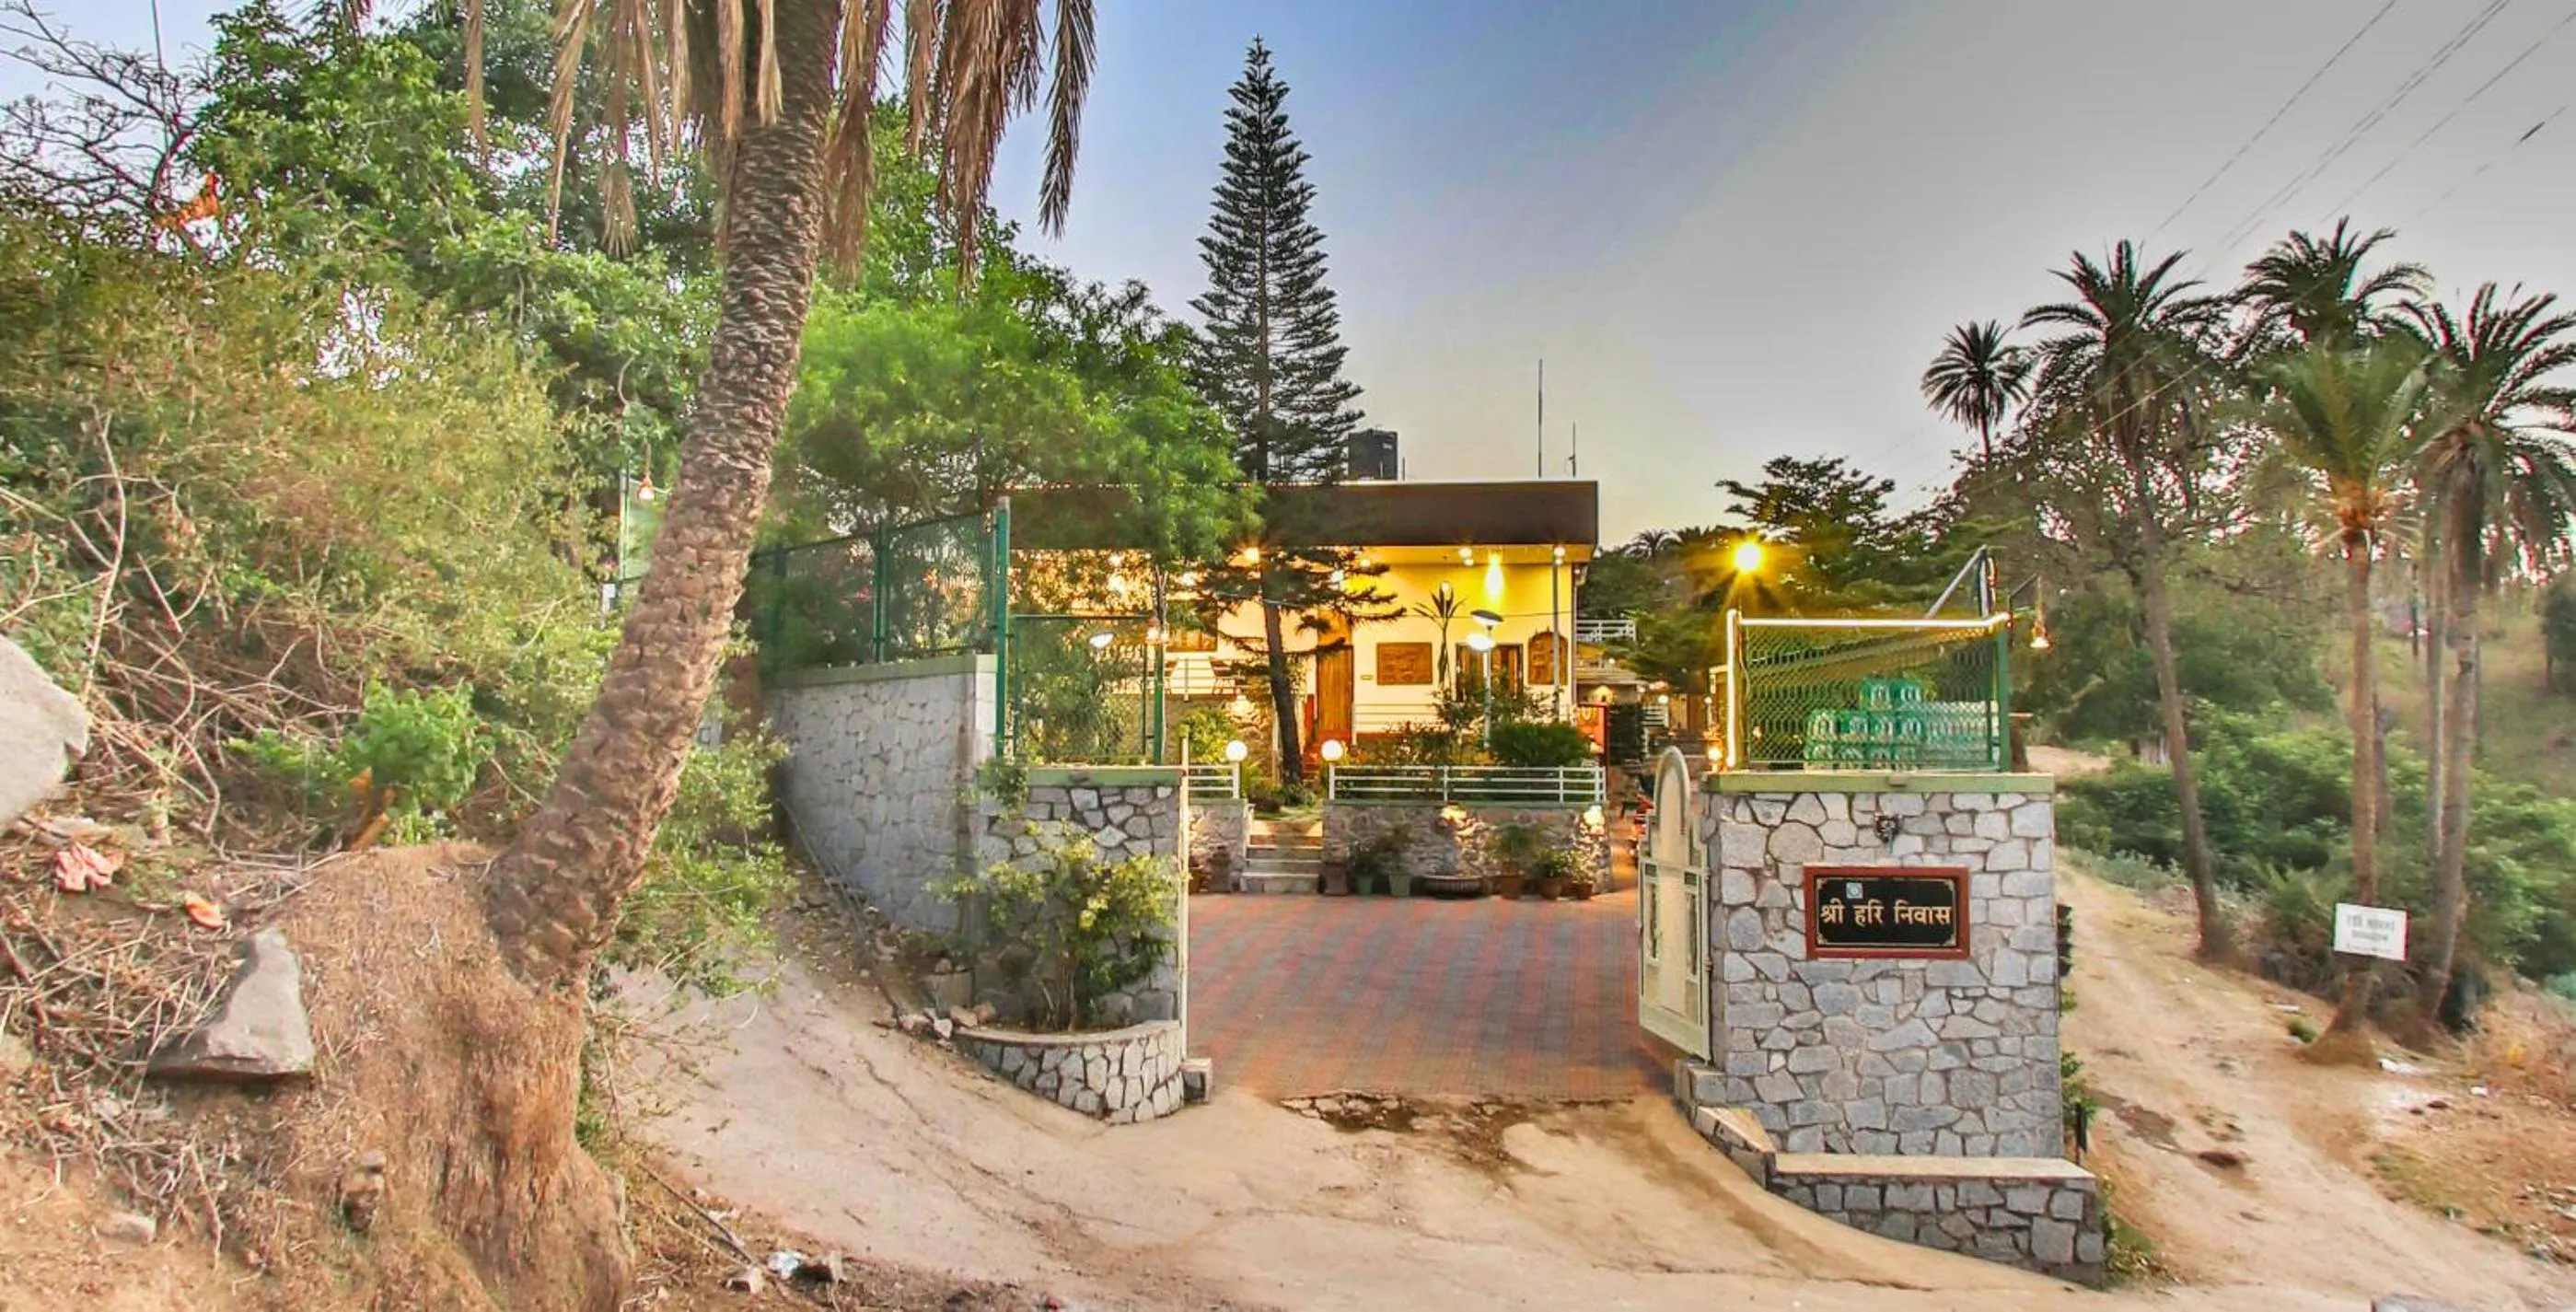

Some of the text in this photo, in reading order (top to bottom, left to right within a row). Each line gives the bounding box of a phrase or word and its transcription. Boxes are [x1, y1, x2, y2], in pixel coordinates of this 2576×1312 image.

[1820, 898, 1952, 926] श्री हरि निवास
